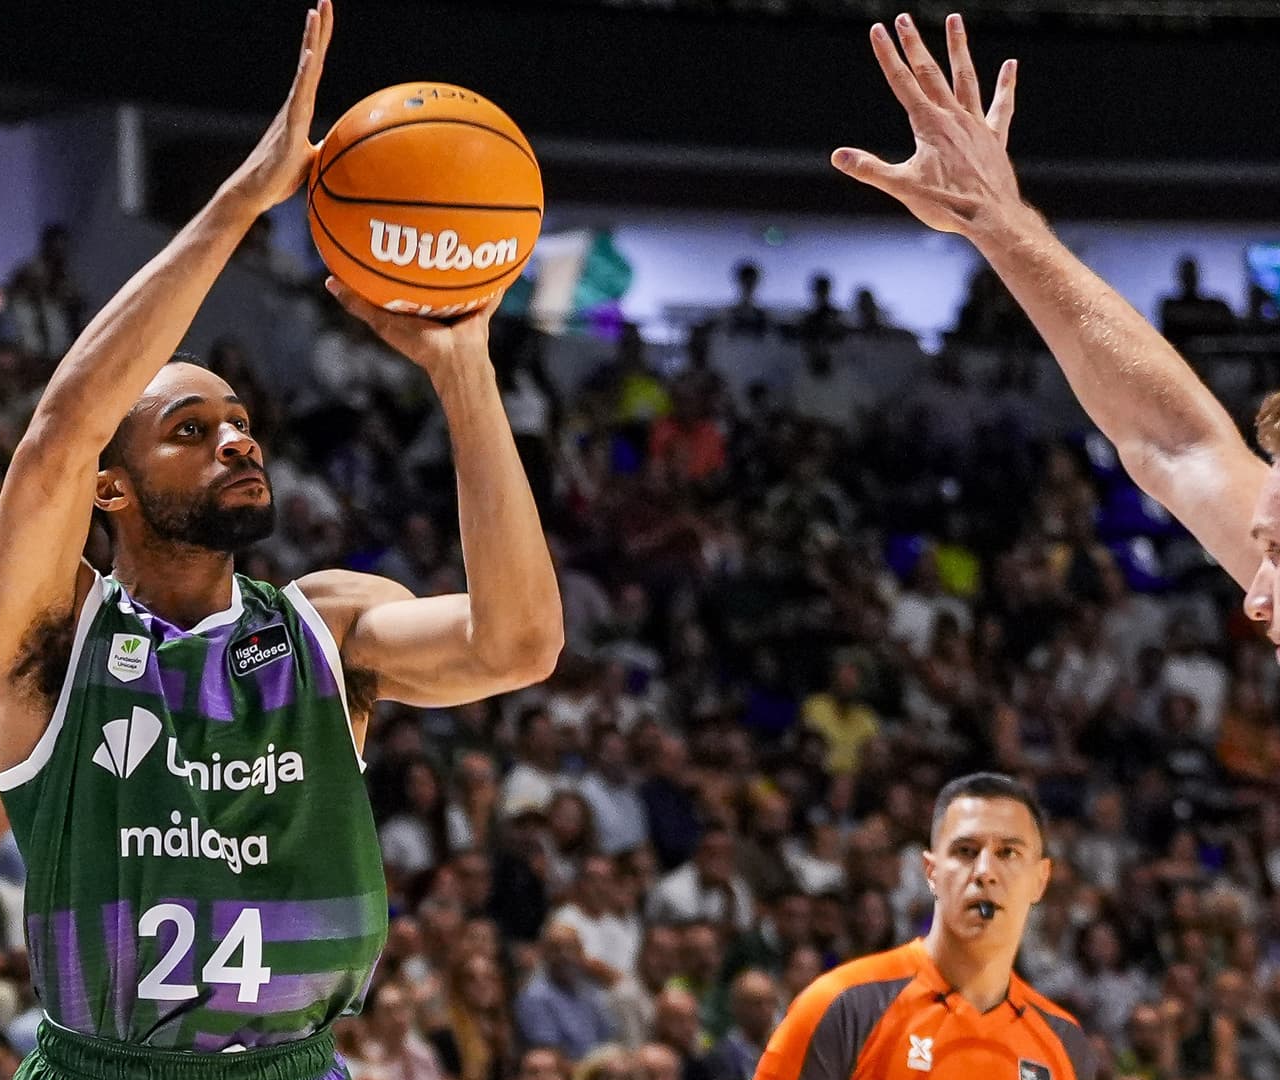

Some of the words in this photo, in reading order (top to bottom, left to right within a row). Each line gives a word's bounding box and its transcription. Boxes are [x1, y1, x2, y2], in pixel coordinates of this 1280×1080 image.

[370, 219, 517, 271] Wilson
[235, 644, 258, 660] liga
[240, 643, 287, 669] endesa
[166, 736, 305, 794] Unicaja
[120, 810, 269, 874] málaga
[137, 903, 272, 1004] 24
